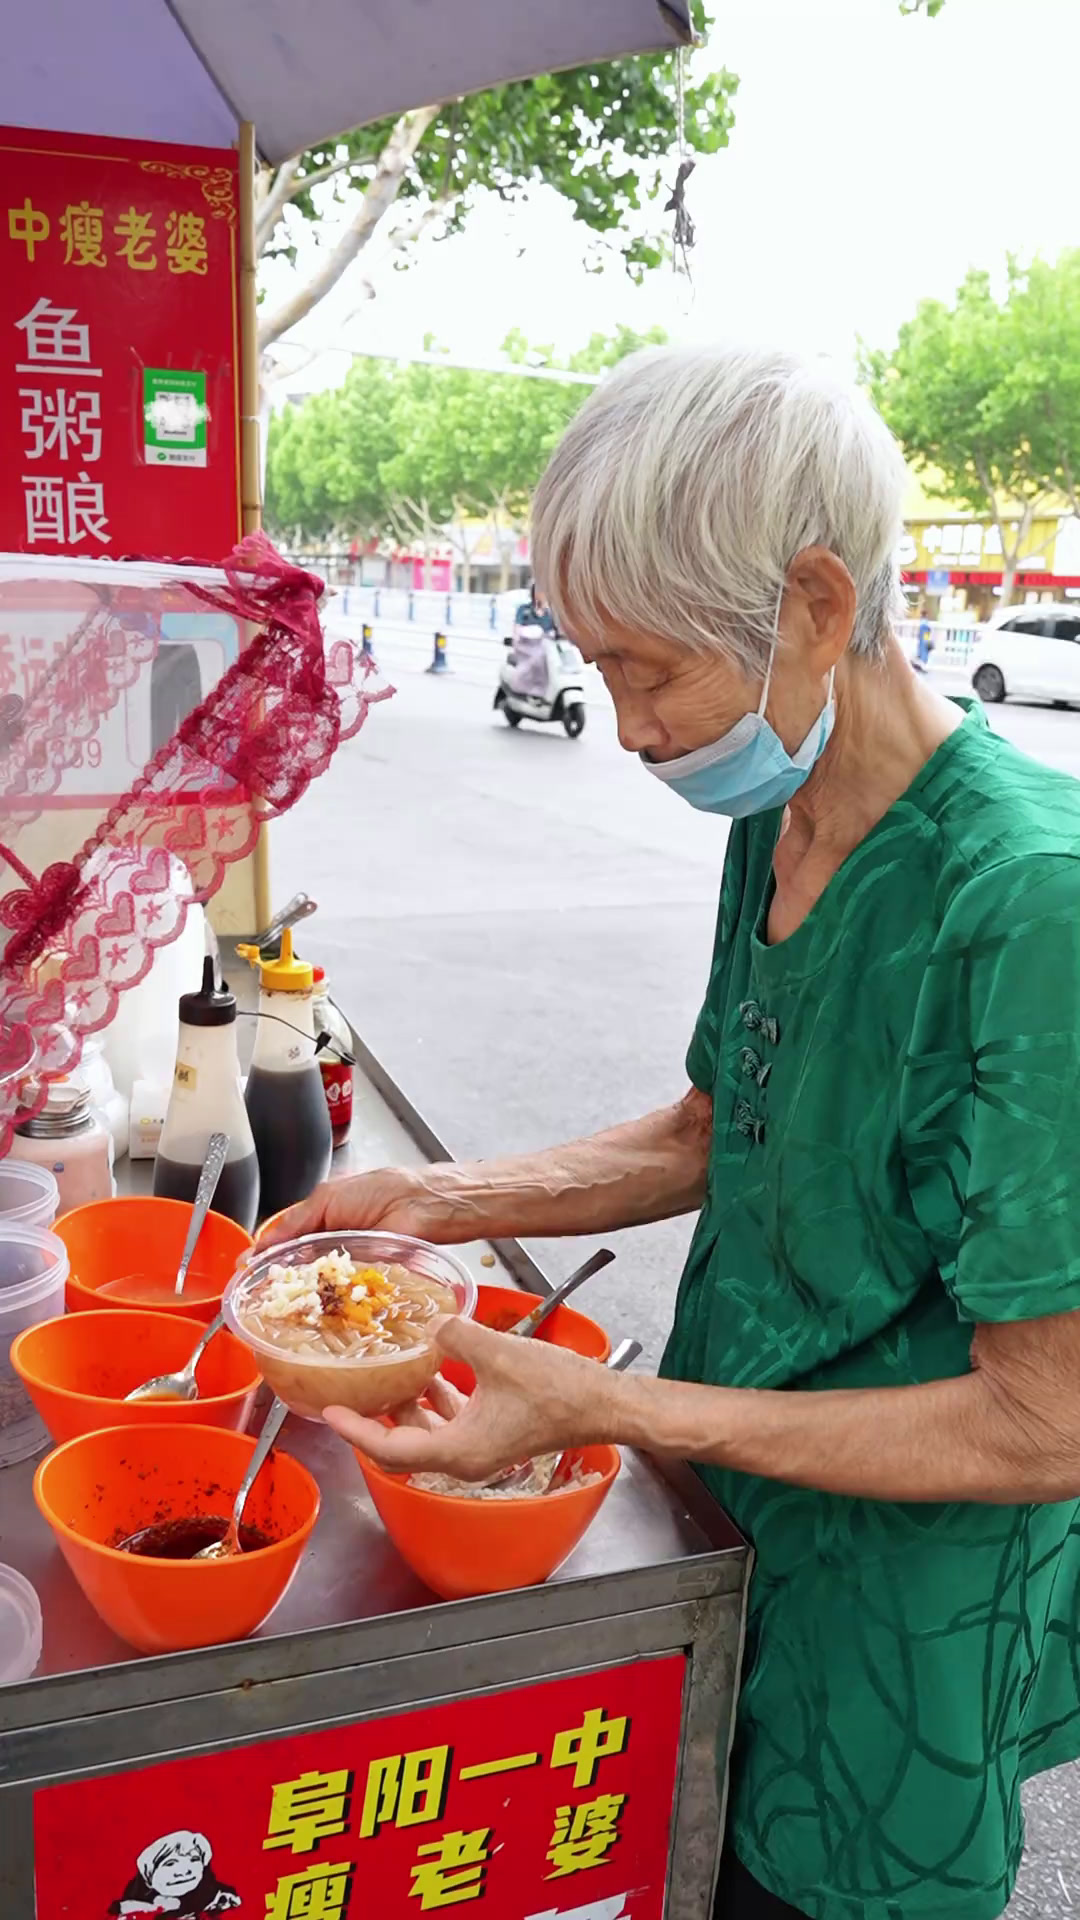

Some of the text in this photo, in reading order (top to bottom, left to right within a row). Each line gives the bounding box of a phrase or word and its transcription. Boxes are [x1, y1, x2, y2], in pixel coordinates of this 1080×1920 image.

[8, 197, 209, 276] 中瘦老婆
[262, 1707, 629, 1855] 阜阳一中
